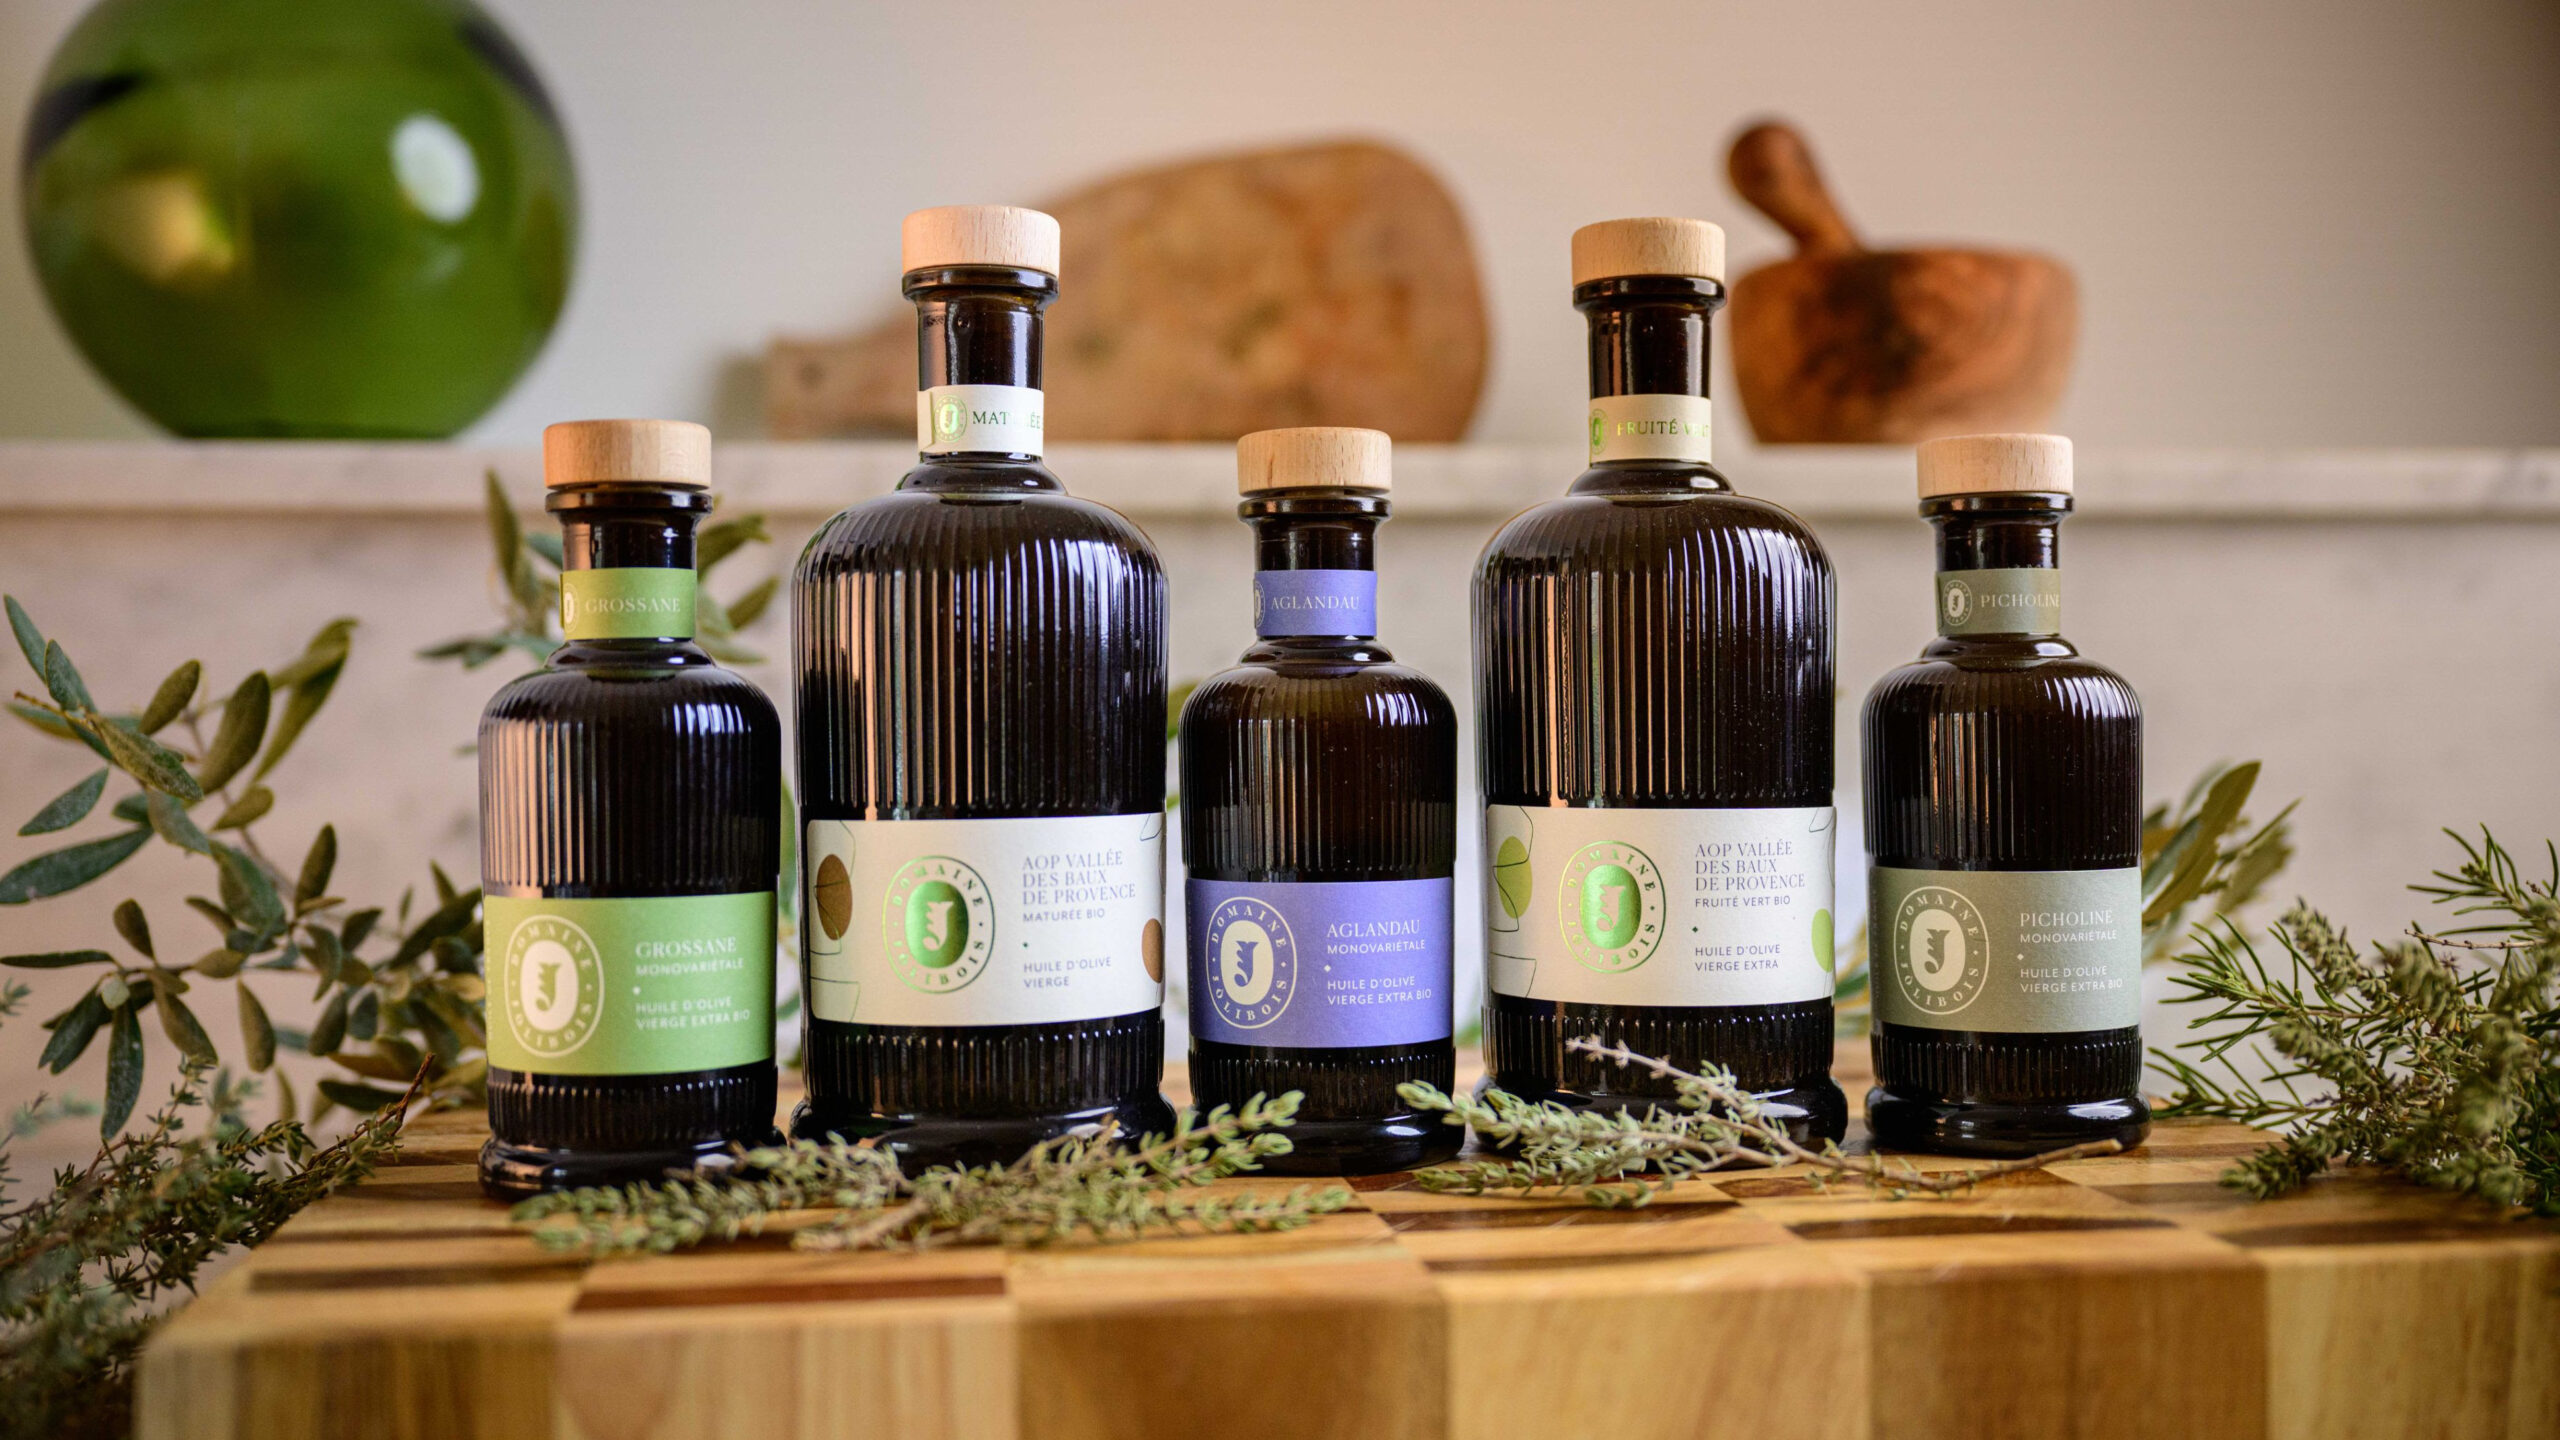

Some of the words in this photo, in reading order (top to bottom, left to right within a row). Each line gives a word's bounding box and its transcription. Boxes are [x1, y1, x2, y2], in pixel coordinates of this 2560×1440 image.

[972, 411, 1041, 429] MATÉE
[1617, 418, 1678, 437] FRUITÉ
[585, 597, 681, 613] GROSSANE
[1271, 596, 1360, 610] AGLANDAU
[1695, 842, 1732, 858] AOP
[1737, 837, 1793, 856] VALLÉE
[1022, 855, 1061, 871] AOP
[1065, 848, 1124, 868] VALLÉE
[1695, 859, 1731, 875] DES
[1736, 859, 1777, 874] BAUX
[1022, 872, 1060, 888] DES
[1064, 869, 1107, 885] BAUX
[1567, 848, 1656, 891] DOMAINE
[893, 864, 983, 908] DOMAINE
[1695, 876, 1720, 892] DE
[1726, 872, 1806, 891] PROVENCE
[1022, 890, 1048, 905] DE
[1054, 883, 1136, 904] PROVENCE
[1695, 894, 1738, 908] FRUITÉ
[1742, 896, 1772, 907] VERT
[1774, 895, 1791, 906] BIO
[1023, 907, 1081, 922] MATURÉE
[1086, 908, 1106, 920] BIO
[1900, 894, 1979, 937] DOMAINE
[2020, 910, 2113, 927] PICHOLINE
[1211, 904, 1287, 949] DOMAINE
[1327, 920, 1421, 938] AGLANDAU
[511, 922, 593, 968] DOMAINE
[2020, 929, 2118, 943] MONOVARIÉTALE
[635, 936, 737, 959] GROSSANE
[1327, 939, 1425, 955] MONOVARIÉTALE
[1695, 946, 1732, 957] HUILE
[1737, 943, 1781, 956] D'OLIVE
[635, 957, 744, 976] MONOVARIÉTALE
[1023, 961, 1063, 974] HUILE
[1067, 956, 1112, 971] D'OLIVE
[1695, 960, 1740, 972] VIERGE
[1744, 959, 1779, 971] EXTRA
[2020, 967, 2059, 979] HUILE
[2063, 964, 2108, 978] D'OLIVE
[1023, 975, 1070, 988] VIERGE
[1327, 978, 1366, 991] HUILE
[1370, 976, 1415, 990] D'OLIVE
[1901, 962, 1979, 1007] JOLIBOIS
[2020, 982, 2067, 994] VIERGE
[2071, 980, 2105, 992] EXTRA
[2108, 978, 2124, 990] BIO
[635, 999, 677, 1014] HUILE
[682, 996, 732, 1012] D'OLIVE
[1212, 975, 1287, 1021] JOLIBOIS
[1327, 992, 1374, 1006] VIERGE
[1378, 990, 1413, 1004] EXTRA
[1416, 988, 1432, 1000] BIO
[635, 1014, 687, 1030] VIERGE
[691, 1012, 730, 1028] EXTRA
[732, 1008, 750, 1023] BIO
